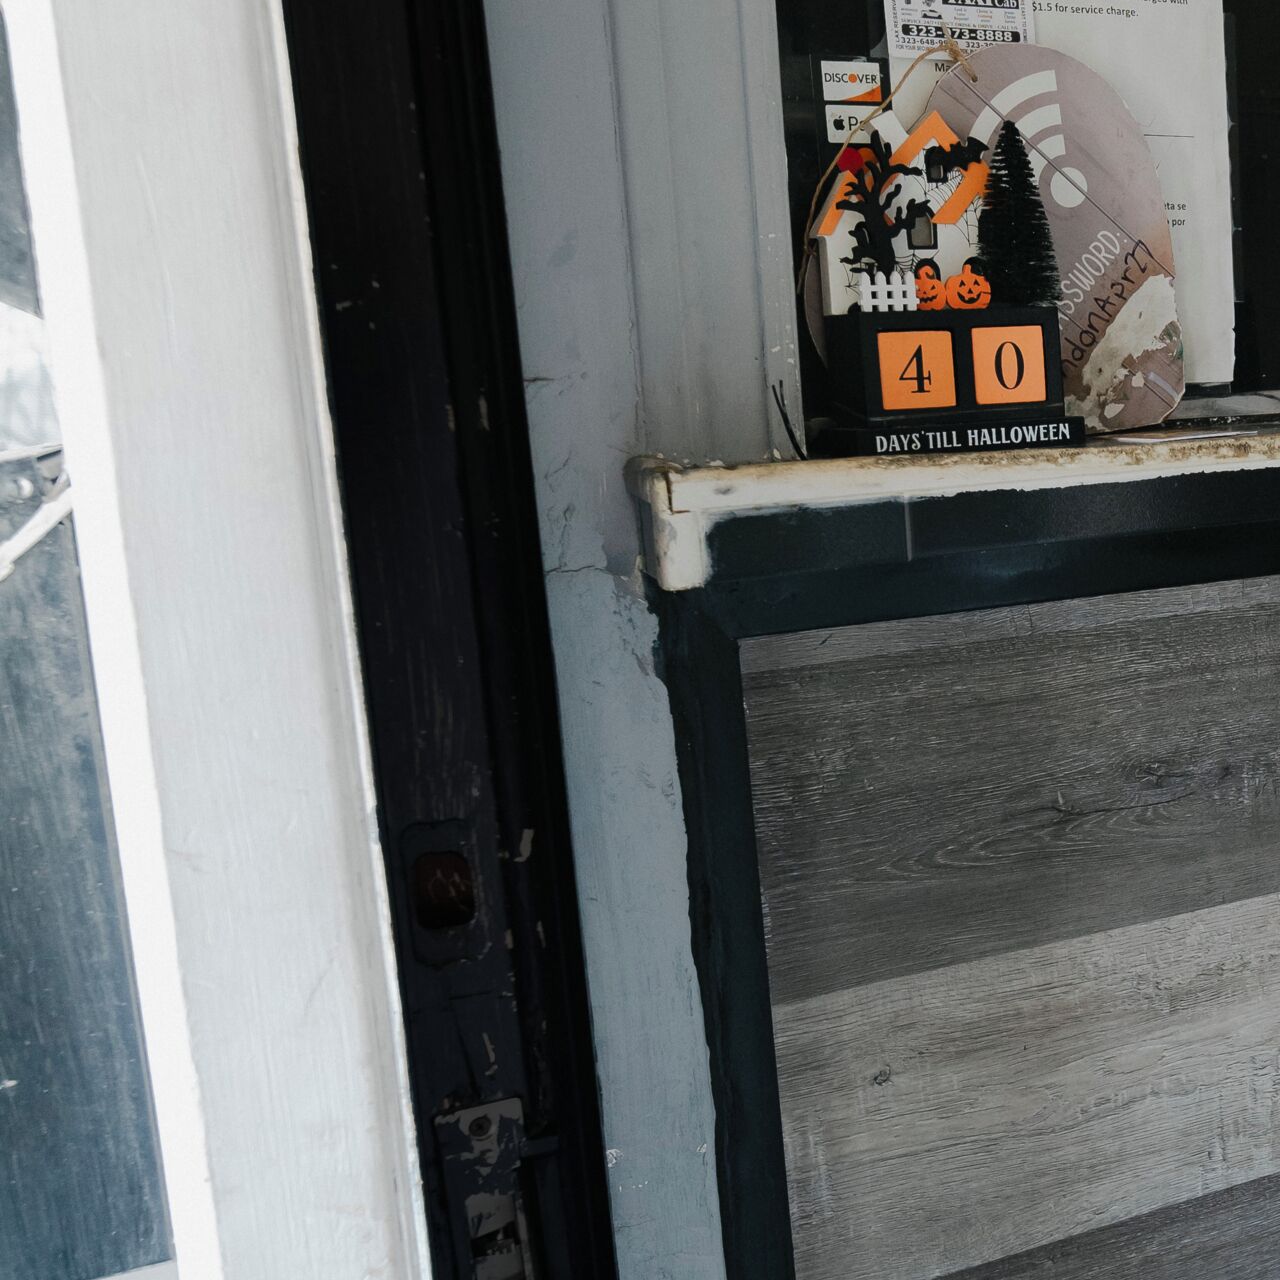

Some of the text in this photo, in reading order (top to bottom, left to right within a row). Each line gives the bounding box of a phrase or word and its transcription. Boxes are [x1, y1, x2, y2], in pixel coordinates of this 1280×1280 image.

[1032, 1, 1139, 18] $1.5 for service charge.
[908, 25, 1013, 42] 323-73-8888
[824, 72, 878, 84] DISCOVER
[1171, 218, 1186, 227] por
[899, 341, 1025, 394] 4 0
[875, 432, 922, 453] DAYS
[967, 423, 1070, 446] HALLOWEEN
